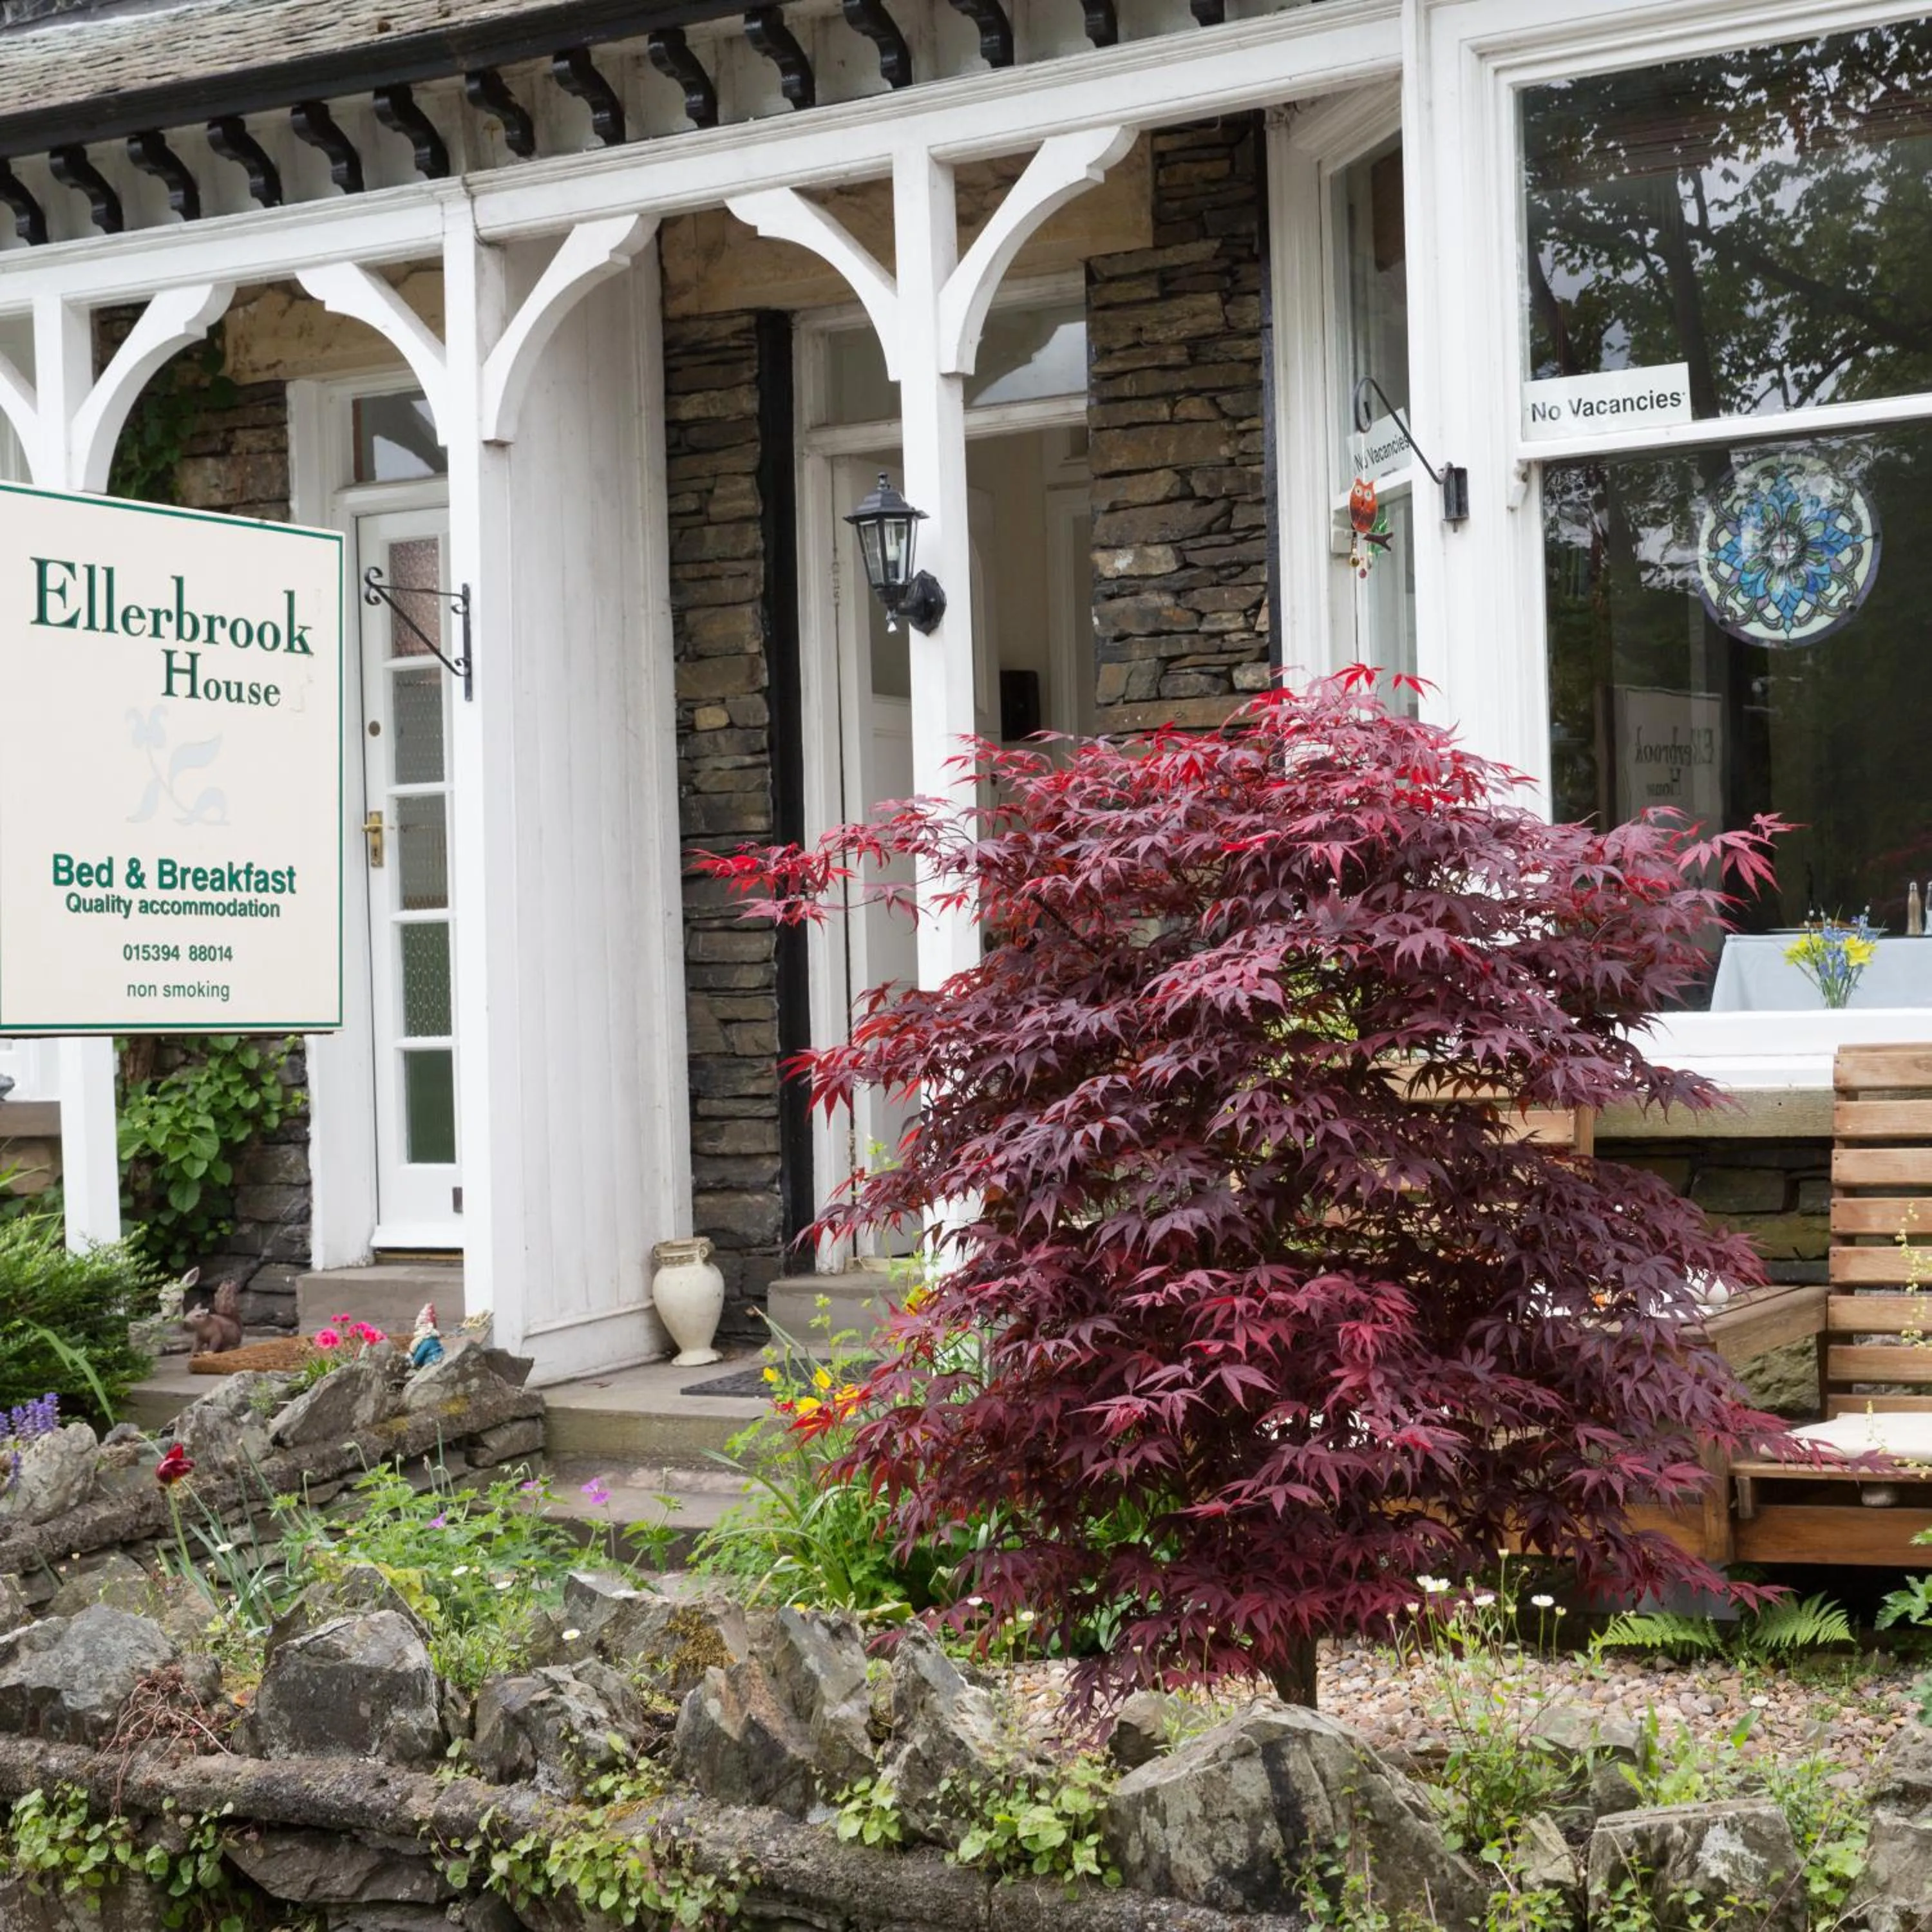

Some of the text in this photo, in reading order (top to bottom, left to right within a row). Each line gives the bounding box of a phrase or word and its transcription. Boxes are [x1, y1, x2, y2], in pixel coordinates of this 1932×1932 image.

[1531, 390, 1681, 422] No Vacancies
[1367, 434, 1410, 464] Vacancies
[30, 556, 314, 656] Ellerbrook
[160, 649, 281, 707] House
[52, 853, 296, 895] Bed & Breakfast
[66, 892, 280, 919] Quality accommodation
[123, 943, 233, 961] 015394 88014
[128, 980, 230, 1001] non smoking
